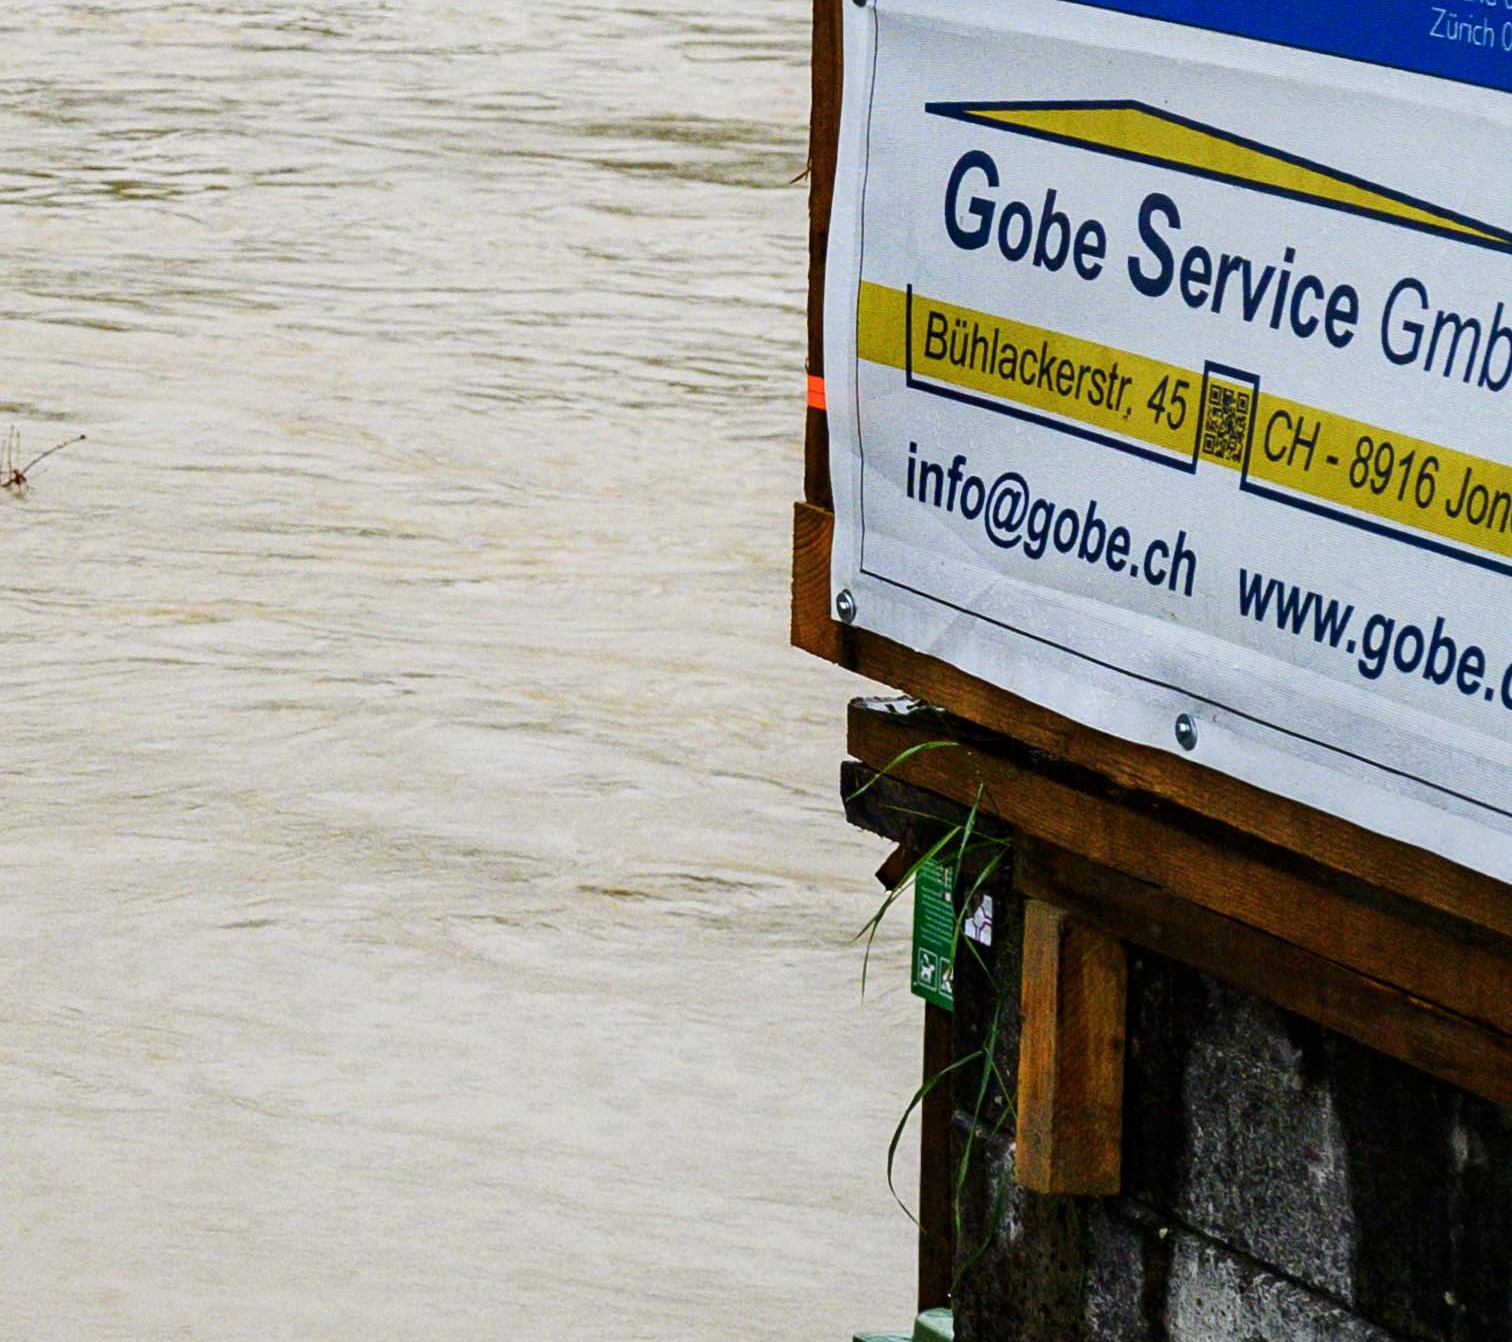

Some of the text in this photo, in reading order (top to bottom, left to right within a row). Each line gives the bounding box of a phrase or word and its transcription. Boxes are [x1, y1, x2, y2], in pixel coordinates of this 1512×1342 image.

[1430, 6, 1494, 47] Zürich
[944, 150, 1512, 392] Gobe Service Gmb
[1147, 374, 1191, 430] 45
[906, 442, 1197, 597] info@gobe.ch
[1263, 409, 1318, 473] CH
[1349, 436, 1440, 509] 8916
[1445, 467, 1512, 535] Jon
